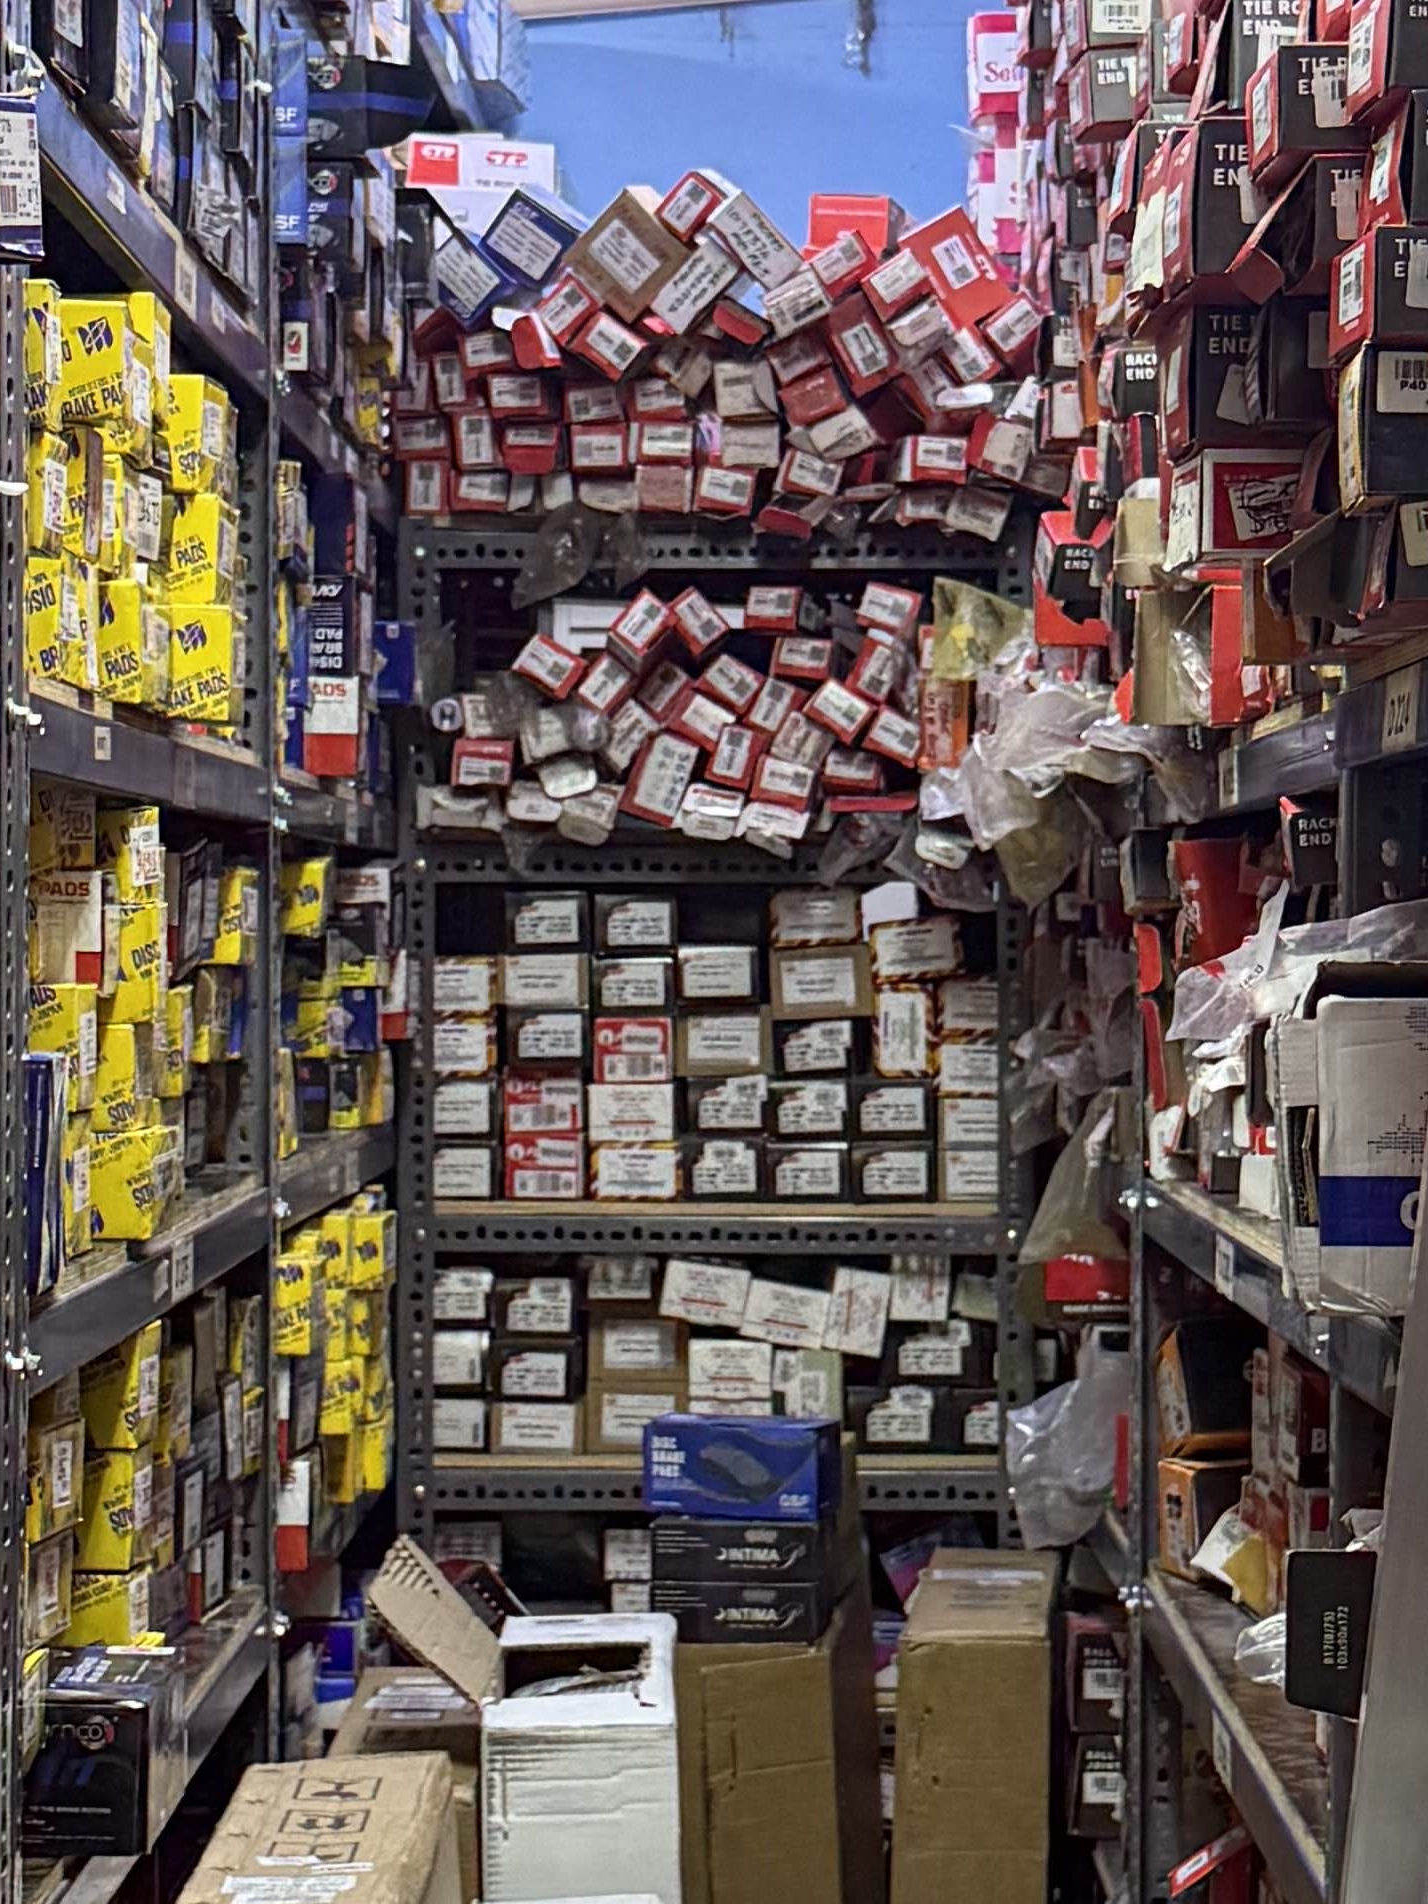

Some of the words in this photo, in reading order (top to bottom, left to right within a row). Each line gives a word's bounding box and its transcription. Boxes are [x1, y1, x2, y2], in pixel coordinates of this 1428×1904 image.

[1242, 0, 1272, 16] TIE
[1097, 72, 1126, 84] END
[1208, 315, 1244, 333] TIE
[1208, 336, 1251, 355] END
[1298, 817, 1337, 832] RACK
[1298, 833, 1332, 847] END
